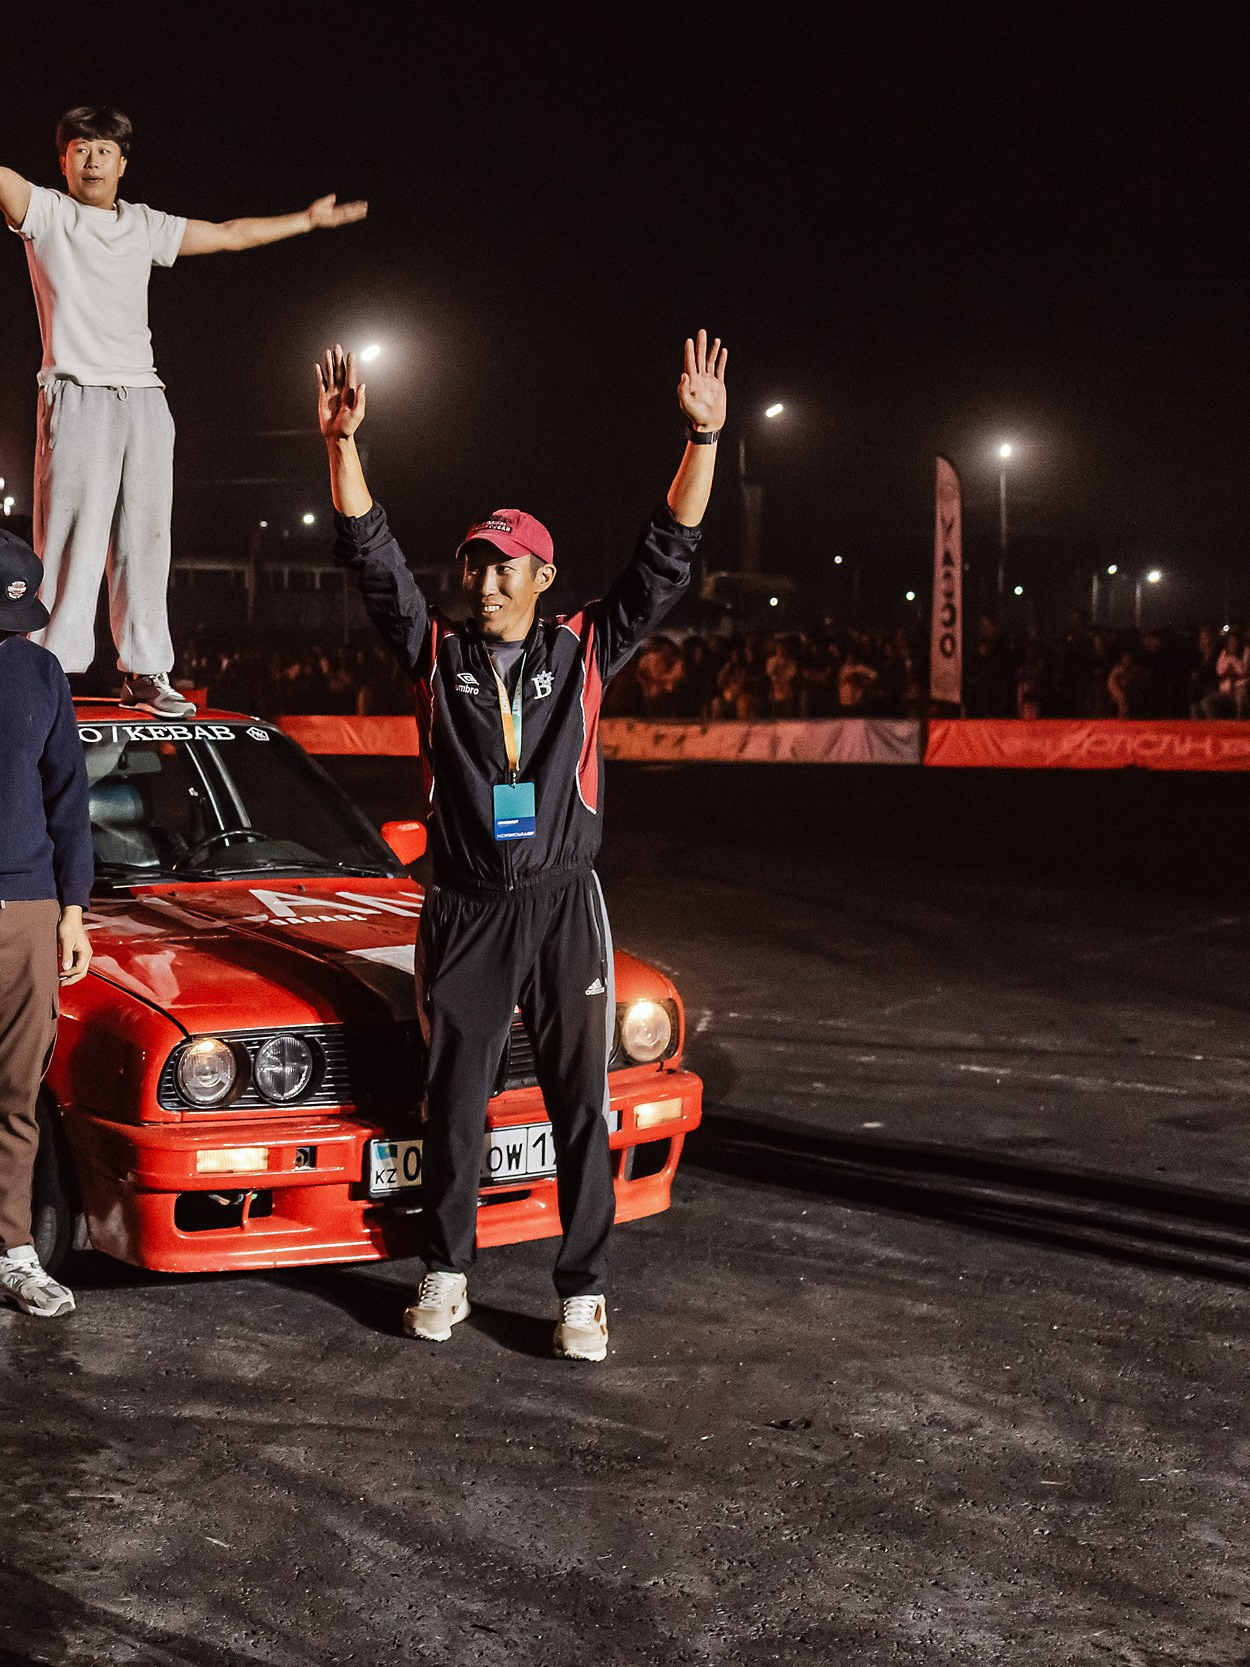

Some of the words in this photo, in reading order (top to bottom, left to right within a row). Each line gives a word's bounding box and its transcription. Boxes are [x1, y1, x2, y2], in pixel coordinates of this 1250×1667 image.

[454, 684, 480, 696] umbro
[121, 725, 236, 742] KEBAB
[486, 1142, 523, 1173] OW
[375, 1169, 397, 1185] KZ
